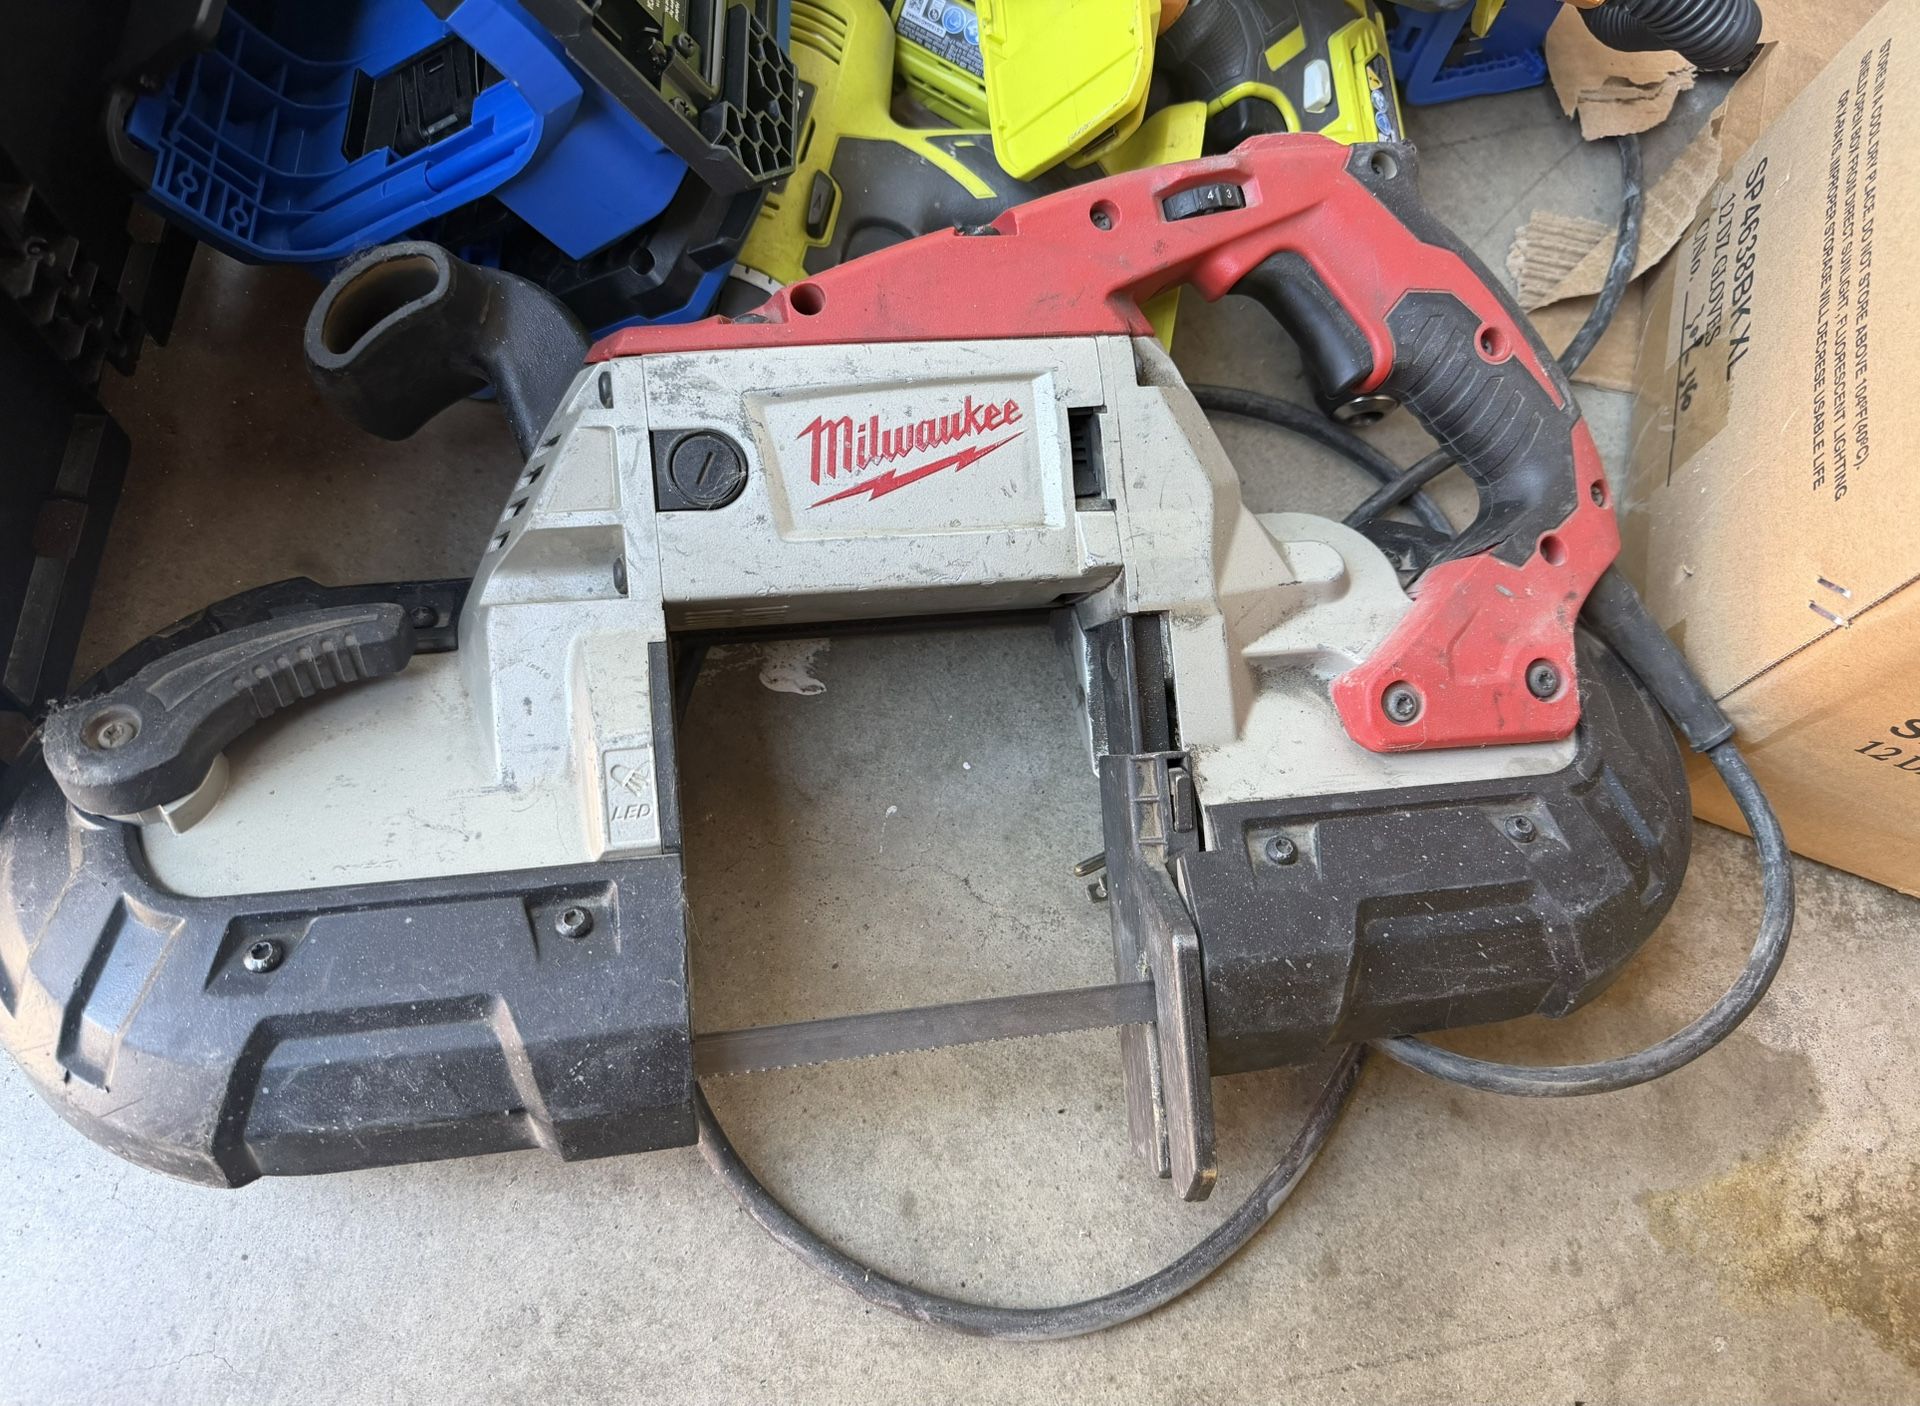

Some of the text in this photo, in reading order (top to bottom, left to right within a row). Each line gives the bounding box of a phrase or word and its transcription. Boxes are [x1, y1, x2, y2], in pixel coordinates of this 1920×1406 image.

[1856, 50, 1872, 95] SHIELD
[1876, 38, 1892, 82] STORE
[1836, 90, 1850, 113] OR
[1872, 95, 1883, 109] A
[1873, 78, 1886, 97] IN
[1852, 92, 1866, 130] OPEN
[1869, 105, 1882, 144] COOL
[1848, 126, 1862, 158] BOX
[1867, 140, 1879, 172] DRY
[1207, 188, 1232, 200] 4 3
[1825, 156, 1840, 224] IMPROPER
[1846, 154, 1859, 195] FROM
[1863, 170, 1876, 221] PLACE.
[1842, 192, 1856, 242] DIRECT
[1862, 218, 1874, 242] DO
[1689, 218, 1710, 282] C/No.
[1705, 193, 1736, 347] 12 DZ GLOVES
[1821, 222, 1835, 289] STORAGE
[1860, 241, 1872, 273] NOT
[1818, 285, 1832, 324] WILL
[1856, 272, 1870, 325] STORE
[1727, 322, 1751, 382] XL
[1814, 321, 1828, 392] DECRESE
[1856, 324, 1868, 379] ABOVE
[795, 395, 1022, 485] Milwaukee
[1813, 390, 1825, 455] USABLE
[1813, 452, 1824, 491] LIFE
[1834, 423, 1847, 501] LIGHTING
[1854, 741, 1902, 761] 12
[611, 803, 651, 821] LED
